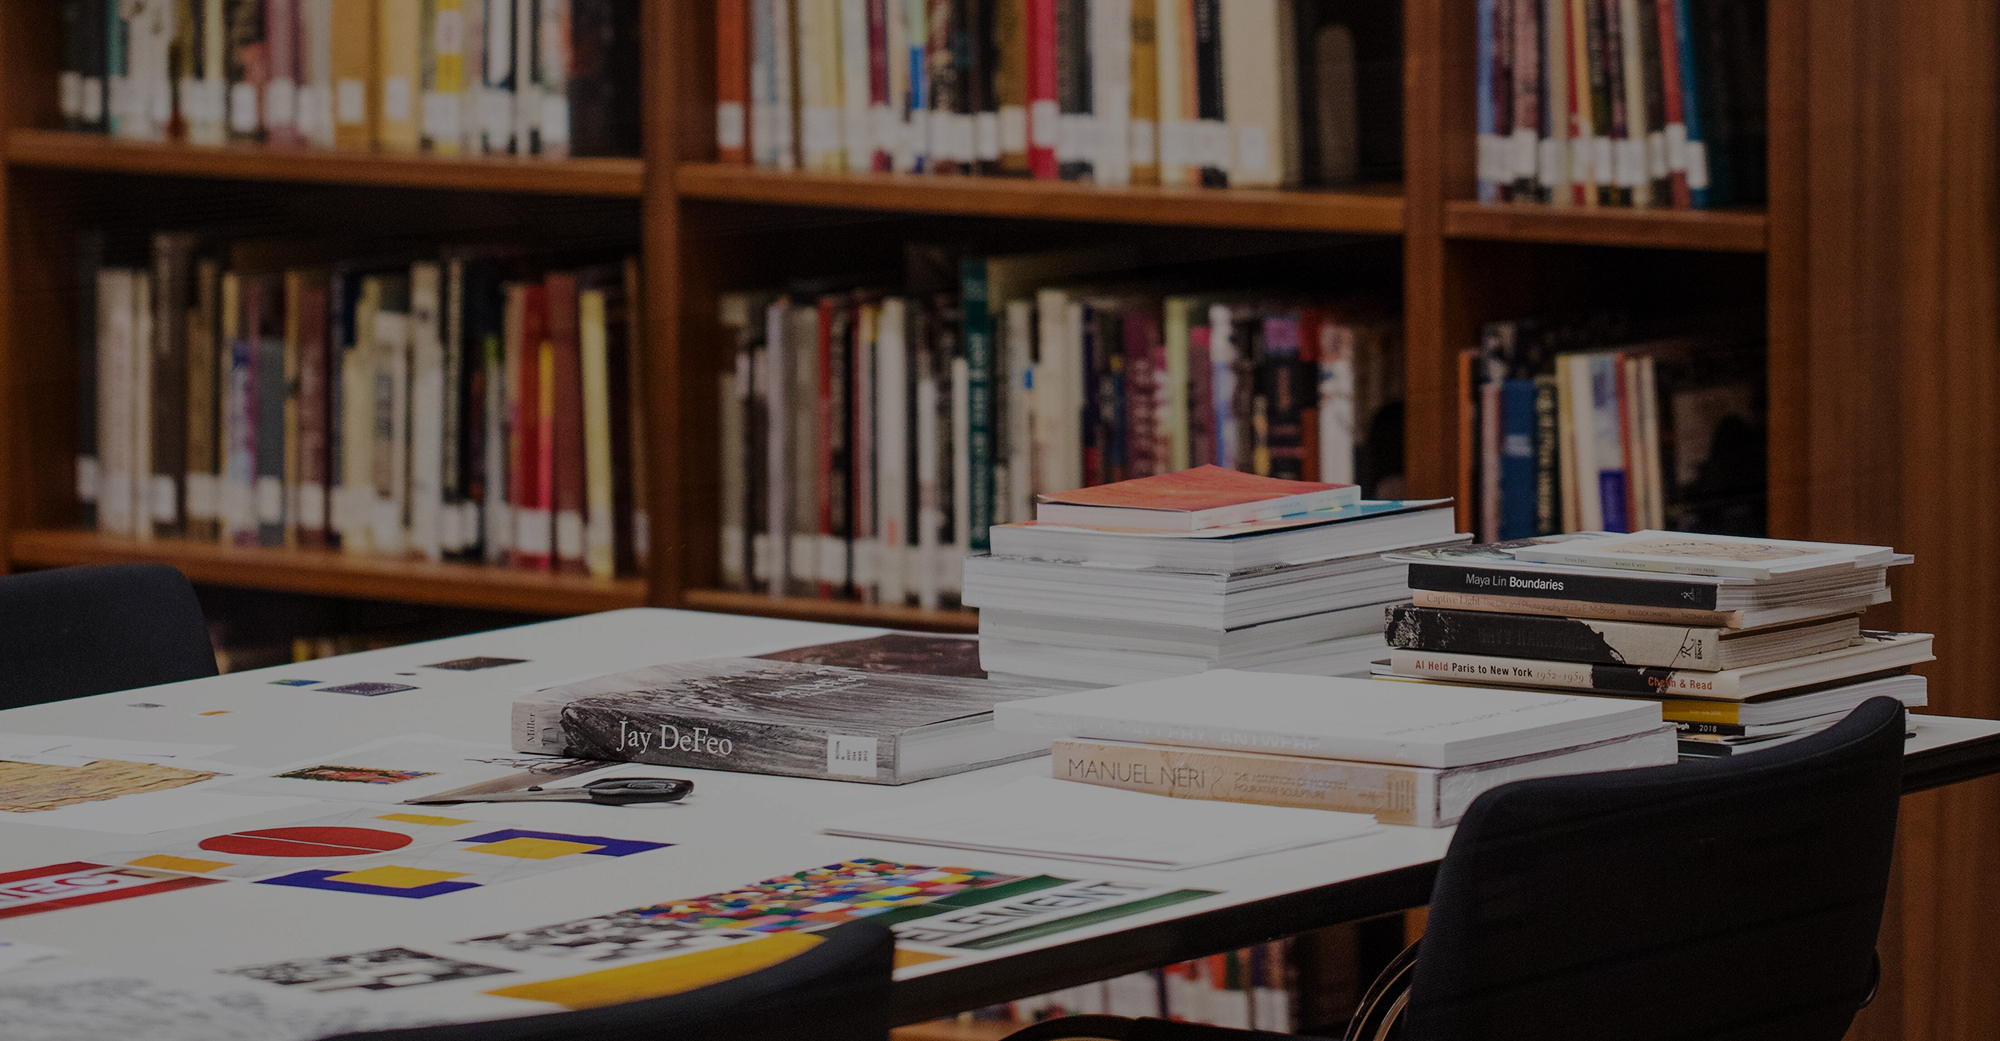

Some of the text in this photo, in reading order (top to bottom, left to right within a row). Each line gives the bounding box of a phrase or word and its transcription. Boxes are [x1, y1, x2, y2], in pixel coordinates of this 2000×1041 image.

[1465, 573, 1565, 591] Maya Lin Boundaries
[1426, 593, 1457, 604] Captive
[1459, 594, 1480, 607] Light
[1415, 660, 1425, 669] Al
[1428, 661, 1448, 671] Held
[1452, 662, 1475, 674] Paris
[1478, 665, 1487, 674] to
[1490, 666, 1509, 676] New
[1512, 667, 1533, 677] York
[1680, 677, 1686, 688] &
[1690, 679, 1713, 690] Read
[526, 713, 536, 743] Miller
[616, 715, 733, 756] Jay DeFeo
[1699, 724, 1717, 732] 2018
[1220, 732, 1320, 751] ANTWERP
[1068, 758, 1154, 785] MANUEL
[1160, 766, 1205, 789] NERI
